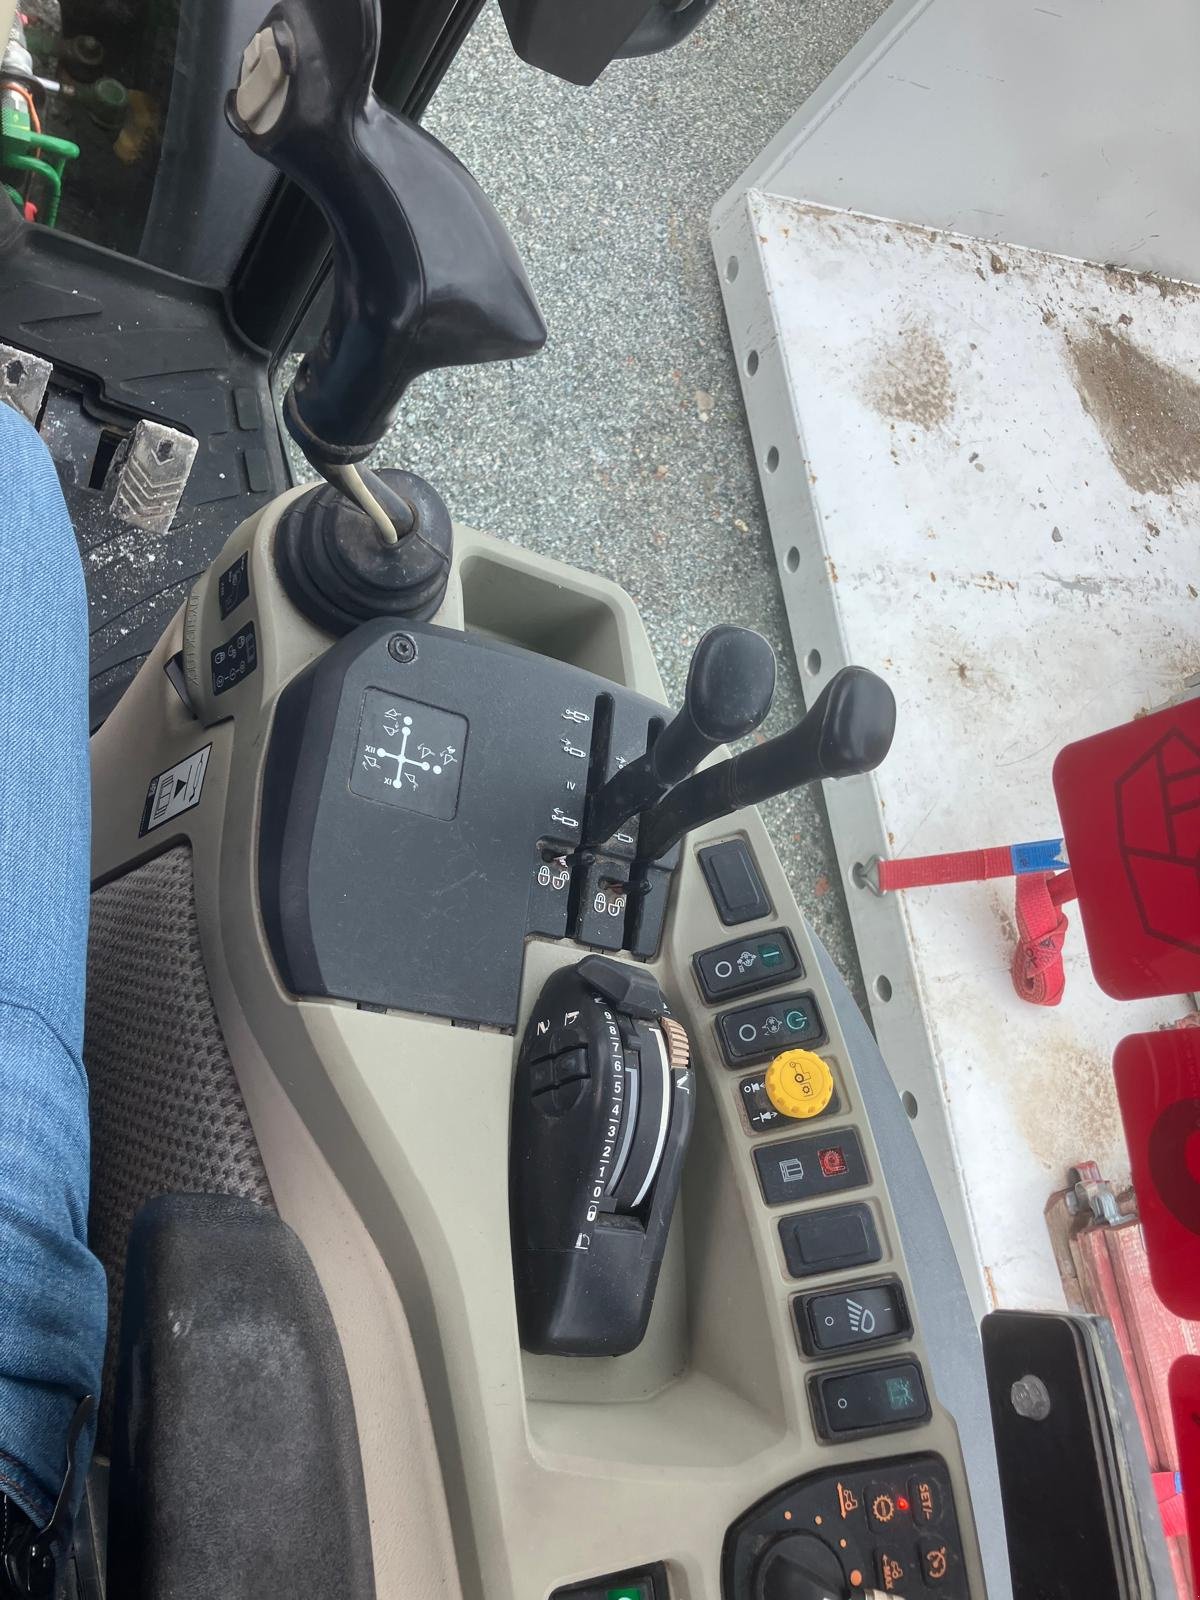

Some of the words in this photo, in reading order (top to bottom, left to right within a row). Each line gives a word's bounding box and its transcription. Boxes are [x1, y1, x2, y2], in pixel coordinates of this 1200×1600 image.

[365, 744, 376, 754] XII
[384, 777, 392, 786] XI
[566, 781, 576, 791] IV
[604, 1011, 612, 1020] 9
[609, 1025, 617, 1035] 8
[612, 1042, 619, 1052] 7
[614, 1060, 622, 1072] 6
[614, 1081, 622, 1094] 5
[611, 1104, 620, 1116] 4
[607, 1125, 616, 1137] 3
[602, 1146, 612, 1157] 2
[599, 1166, 606, 1178] 1
[593, 1186, 602, 1198] 0
